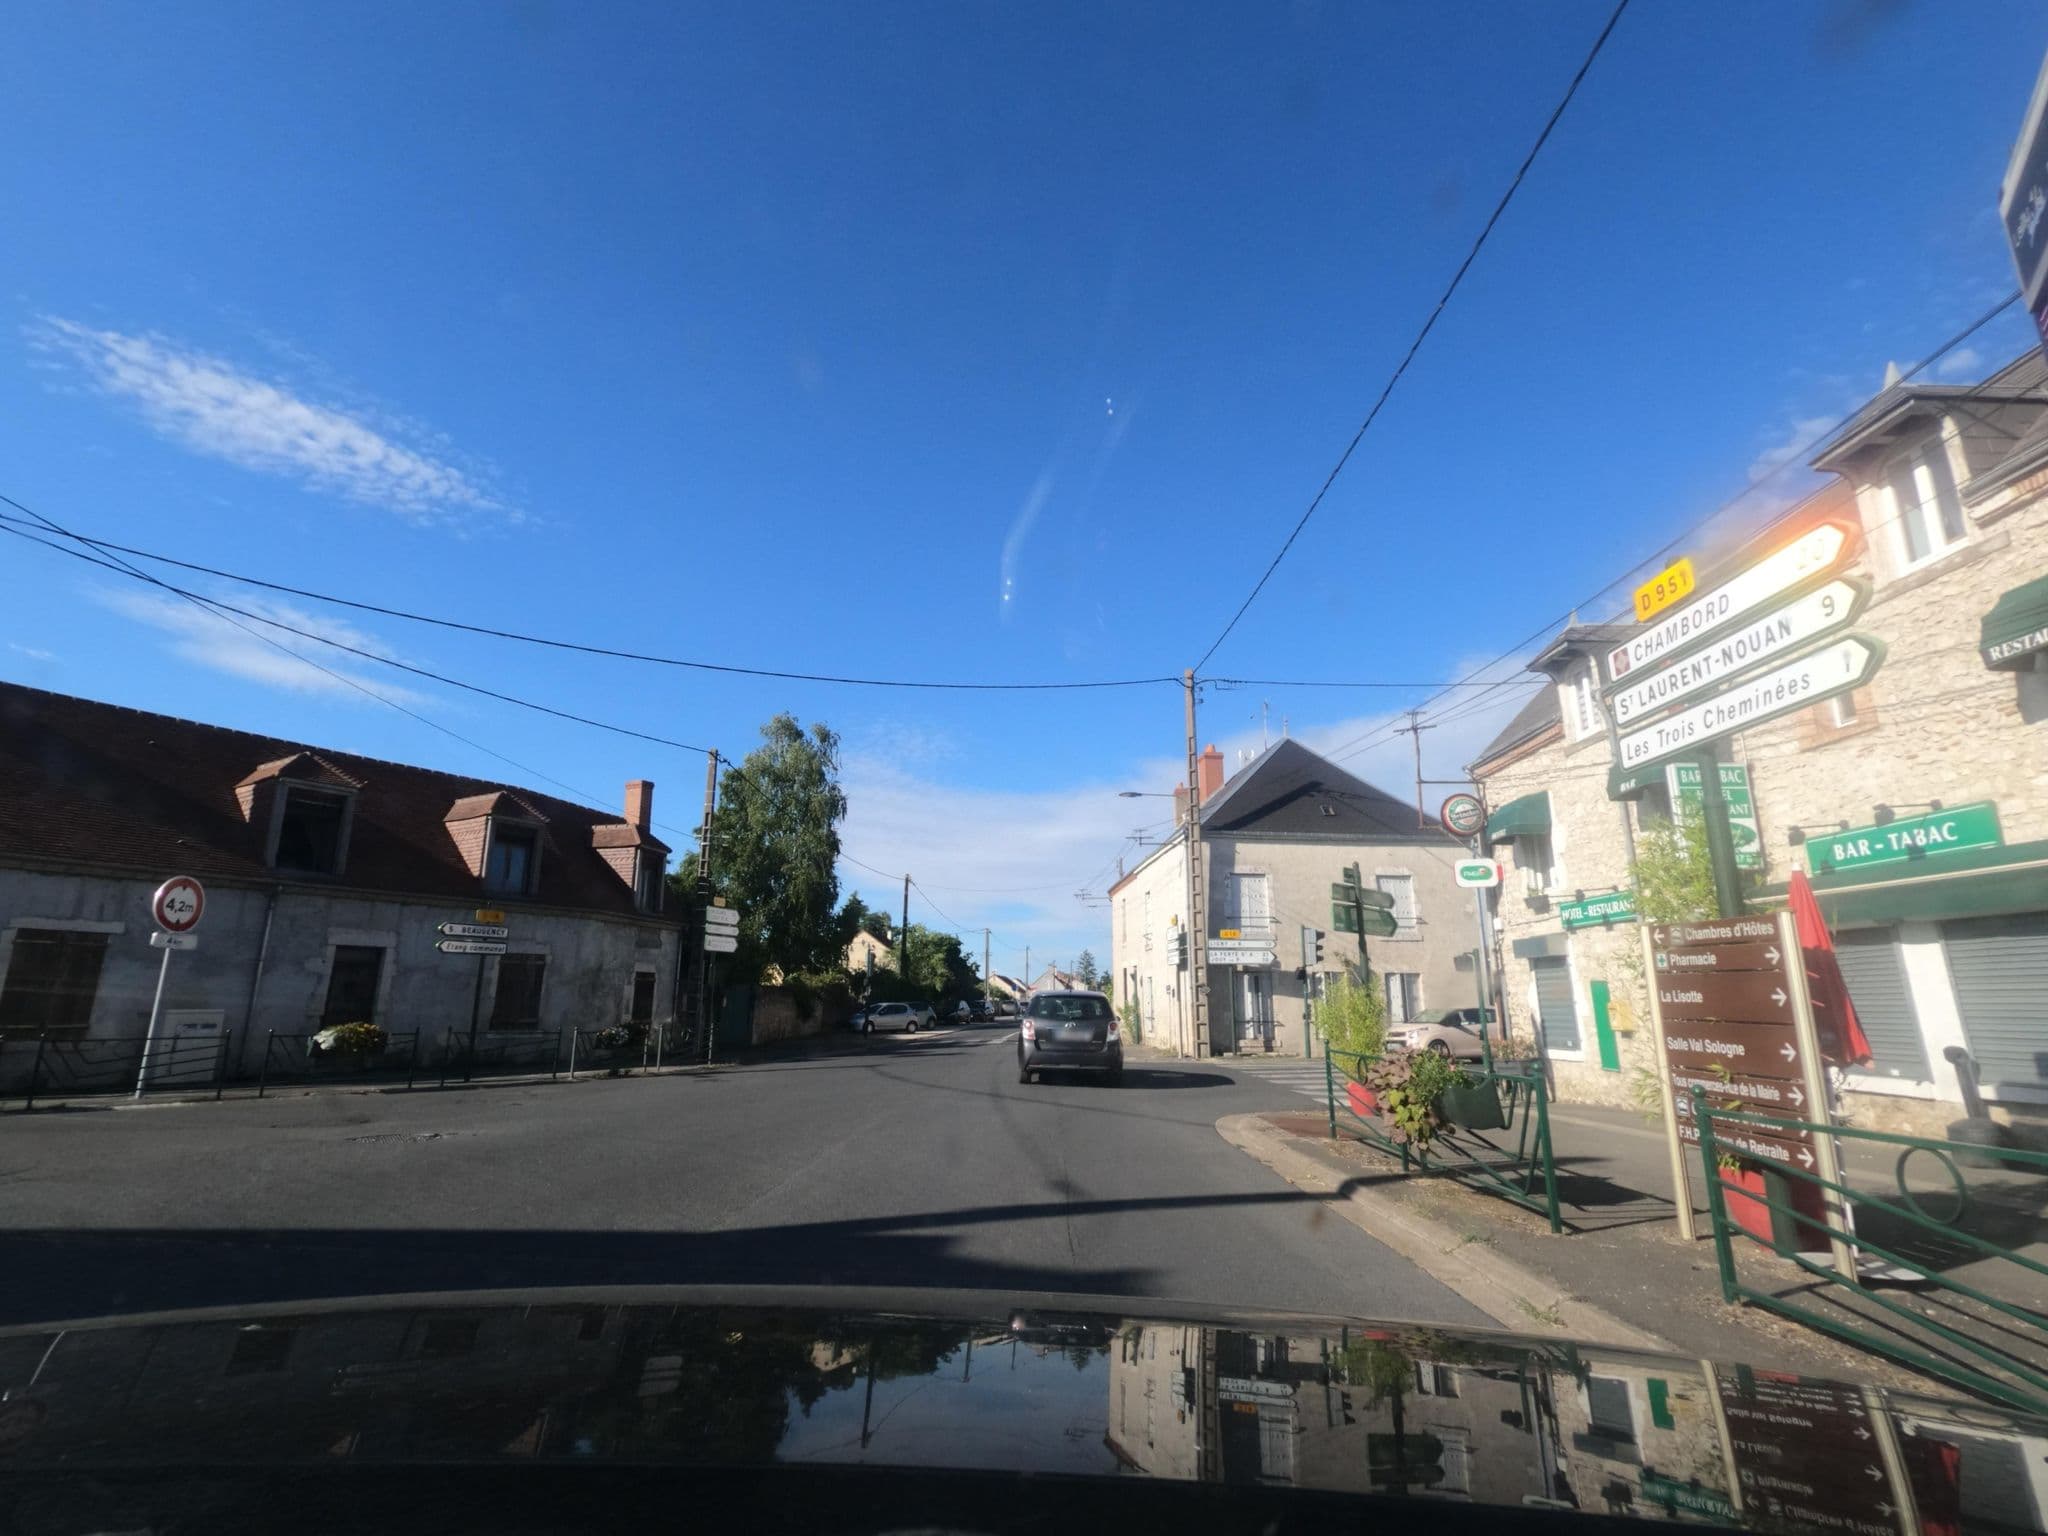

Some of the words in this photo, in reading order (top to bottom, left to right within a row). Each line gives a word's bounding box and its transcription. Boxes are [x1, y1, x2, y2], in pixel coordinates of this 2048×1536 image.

[1633, 593, 1730, 662] CHAMBORD
[1638, 616, 1792, 708] LAURENT-NOUAN
[1821, 594, 1836, 617] 9
[1626, 739, 1649, 761] Les
[1656, 721, 1695, 748] Trois
[1702, 672, 1811, 730] Cheminées
[1832, 839, 1872, 862] BAR
[1887, 821, 1959, 851] TABAC
[1684, 926, 1732, 941] Chambres
[1733, 921, 1775, 938] d'Hôtes
[1669, 951, 1717, 966] Pharmacie
[1660, 990, 1672, 1003] La
[1672, 989, 1704, 1003] Lisotte
[1666, 1036, 1689, 1050] Salle
[1688, 1038, 1703, 1052] Val
[1703, 1040, 1746, 1058] Sologne
[1748, 1138, 1790, 1161] Retraite
